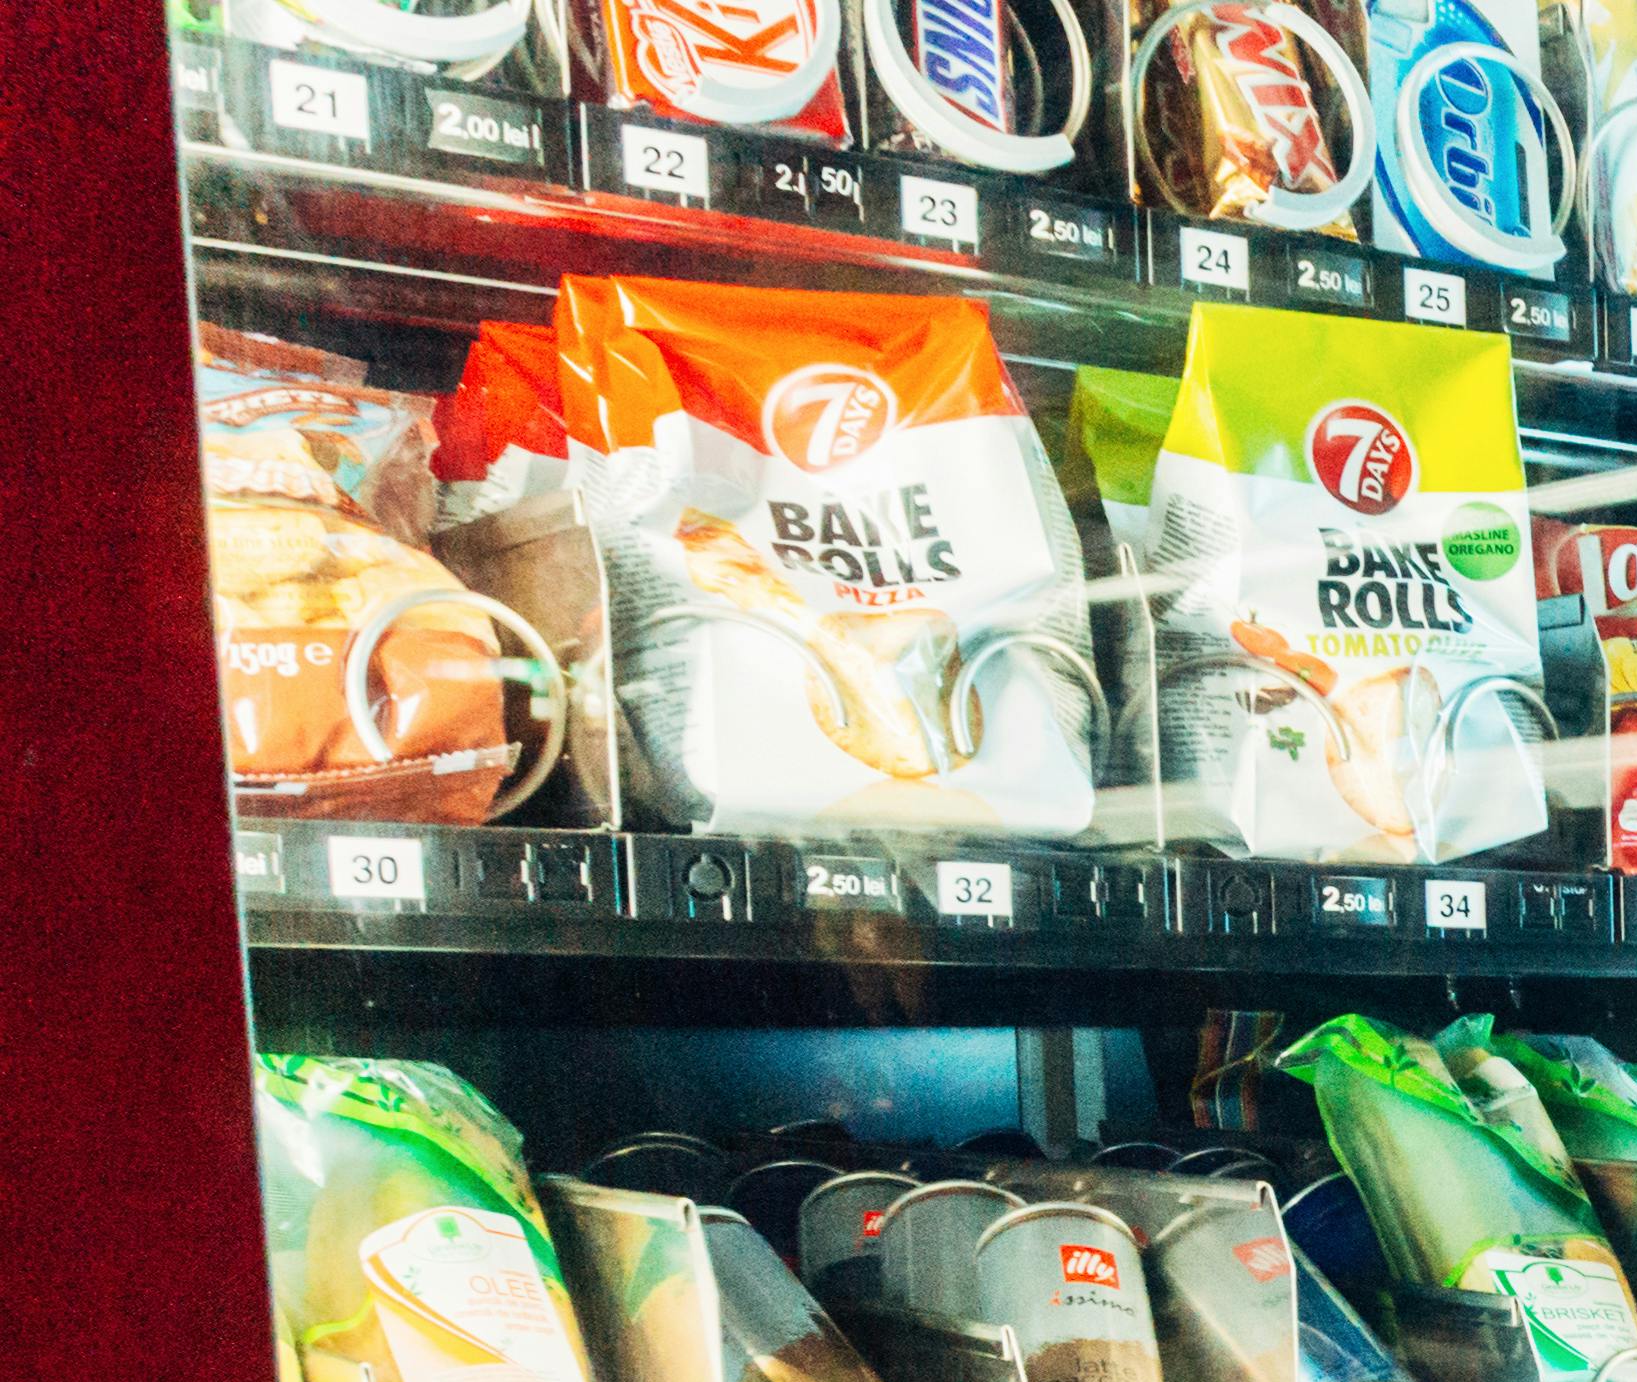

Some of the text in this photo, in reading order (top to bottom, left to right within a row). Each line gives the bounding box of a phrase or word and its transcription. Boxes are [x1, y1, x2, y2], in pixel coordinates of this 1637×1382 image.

[296, 84, 338, 118] 21
[1212, 2, 1338, 184] WIX
[643, 145, 686, 180] 22
[919, 194, 959, 226] 23
[1197, 245, 1232, 275] 24
[1418, 285, 1451, 312] 25
[780, 380, 858, 467] 7
[832, 383, 884, 458] DAYS
[1325, 416, 1383, 503] 7
[1360, 426, 1402, 503] DAYS
[770, 538, 963, 590] ROLLS
[1318, 526, 1450, 587] BAKE
[1448, 541, 1515, 557] OREGANO
[834, 580, 927, 608] PIZZA
[1316, 578, 1476, 635] ROLLS
[228, 640, 299, 678] 150g
[1305, 632, 1423, 659] TOMATO
[352, 855, 399, 886] 30
[955, 877, 994, 904] 32
[1440, 893, 1471, 918] 34
[1065, 1251, 1116, 1281] illy
[1049, 1289, 1136, 1319] issimo
[1540, 1305, 1627, 1324] BRISKET
[1074, 1356, 1138, 1380] latte
